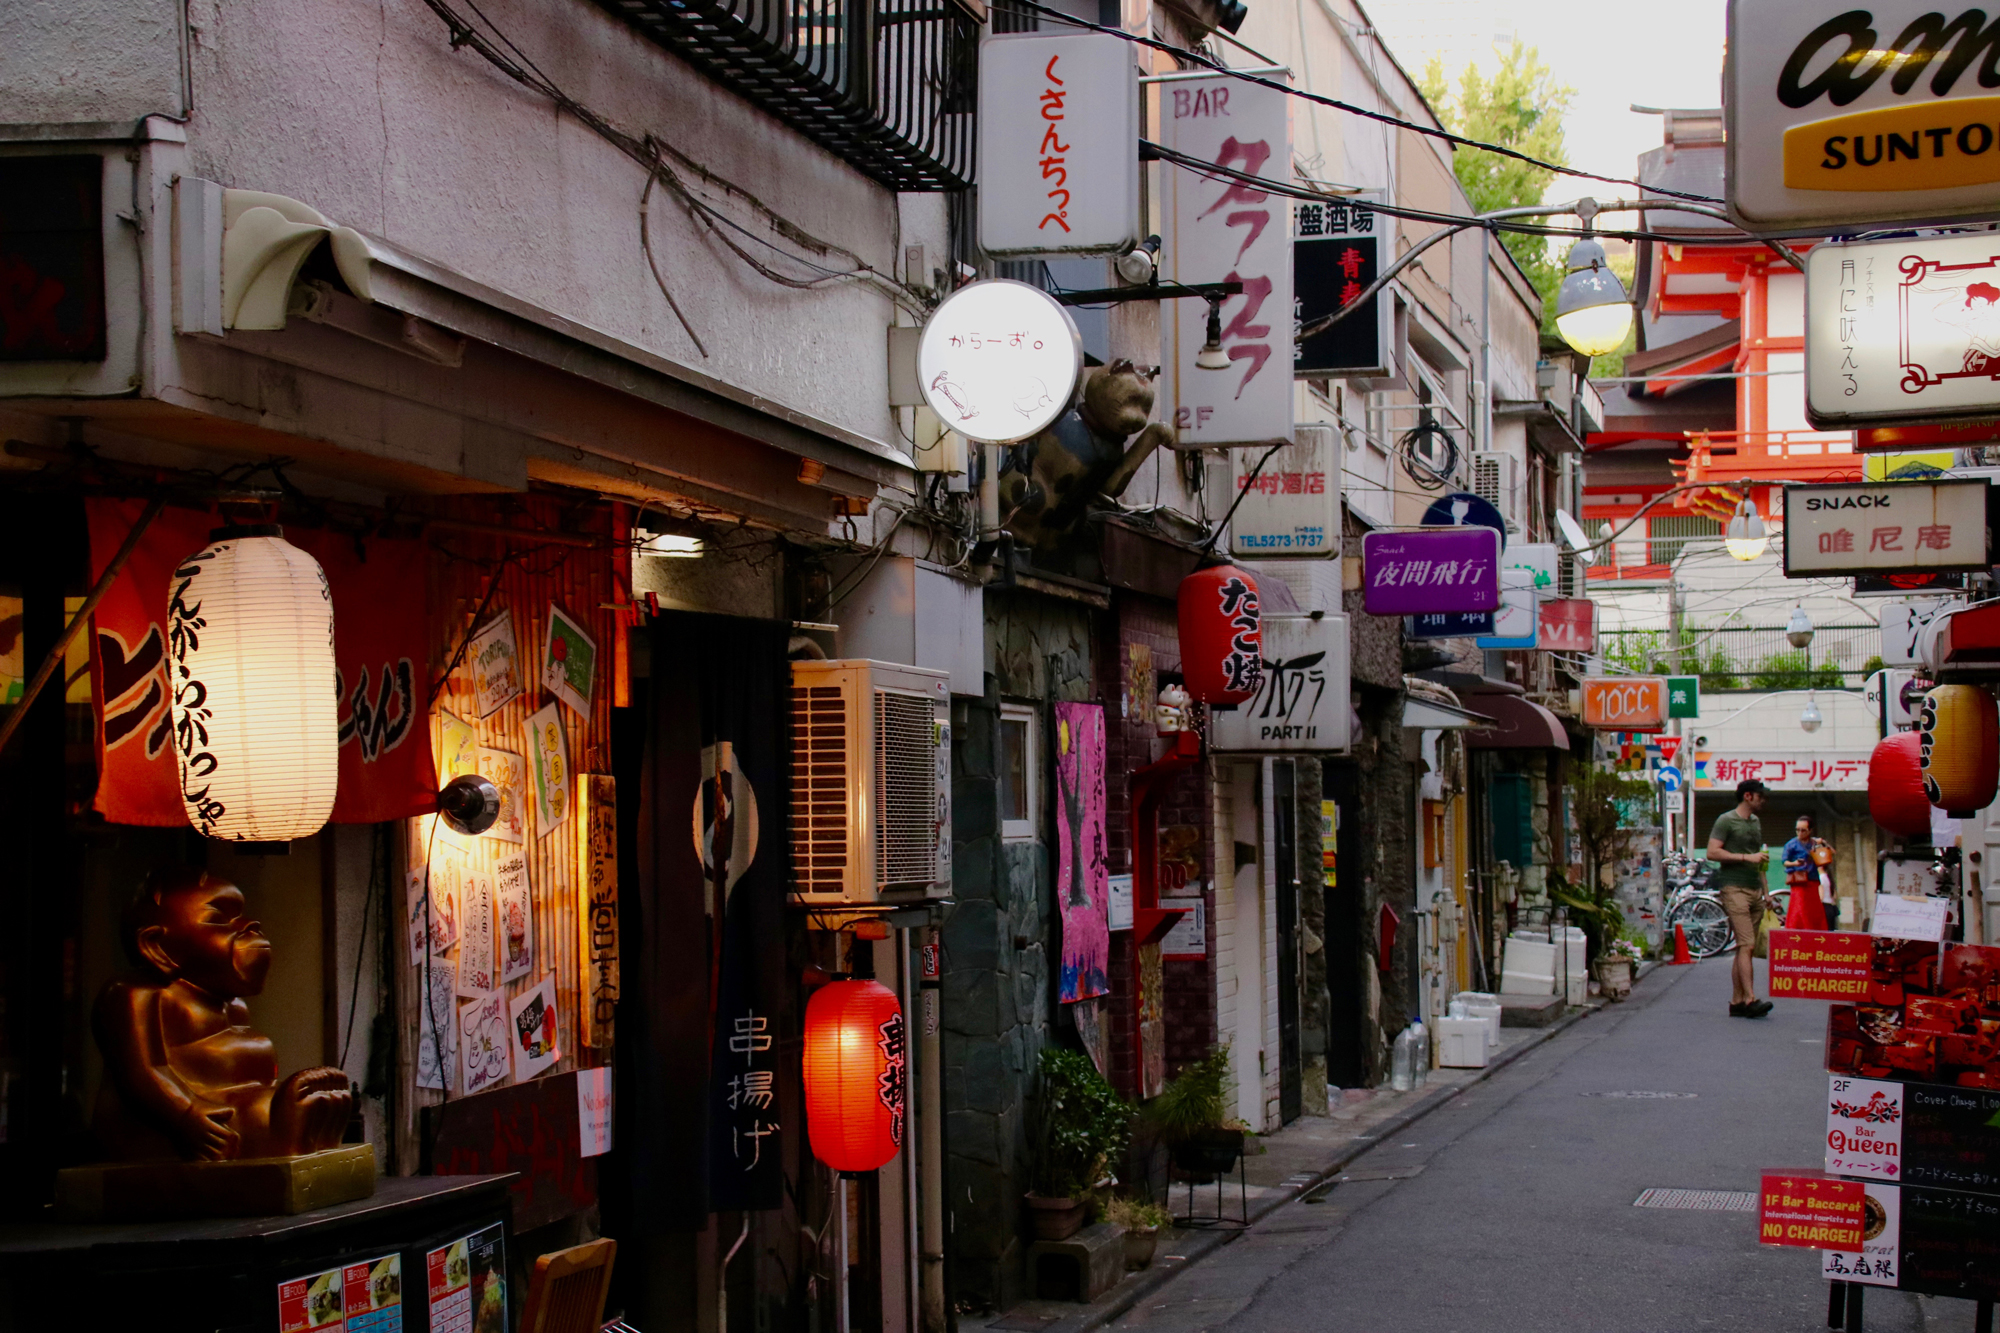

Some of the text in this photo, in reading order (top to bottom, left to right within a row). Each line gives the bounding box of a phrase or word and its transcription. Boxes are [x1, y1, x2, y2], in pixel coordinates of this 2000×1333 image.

[1173, 87, 1231, 118] BAR
[1820, 122, 2000, 170] SUNTO
[1294, 201, 1374, 237] 盤酒場
[1839, 259, 1858, 397] 月に吠える
[1175, 405, 1214, 430] 2F
[1237, 472, 1325, 495] 中村酒店
[1806, 495, 1890, 511] SNACK
[1373, 545, 1405, 556] Snack
[1373, 558, 1488, 588] 夜間飛行
[1473, 590, 1489, 602] 2F
[168, 545, 230, 840] どんがらがっしゃ
[1596, 684, 1650, 721] 10CC
[1261, 725, 1303, 740] PART
[1715, 758, 1868, 782] 新宿ゴールデ
[1774, 949, 1868, 963] 1F Bar Baccarat
[1774, 965, 1821, 974] International
[1823, 967, 1852, 976] tourists
[1772, 976, 1868, 994] NO CHARGE!!
[727, 1008, 781, 1173] 串揚げ
[1834, 1080, 1851, 1092] 2F
[1914, 1091, 1947, 1106] Cover
[1950, 1094, 1977, 1110] Charge
[1855, 1125, 1876, 1138] Bar
[1828, 1129, 1898, 1156] Queen
[1765, 1194, 1862, 1213] 1F Bar Baccarat
[1765, 1210, 1859, 1225] International tourists are
[1762, 1223, 1861, 1244] NO CHARGE!!
[353, 1267, 369, 1279] FOOD
[290, 1283, 306, 1296] FOOD
